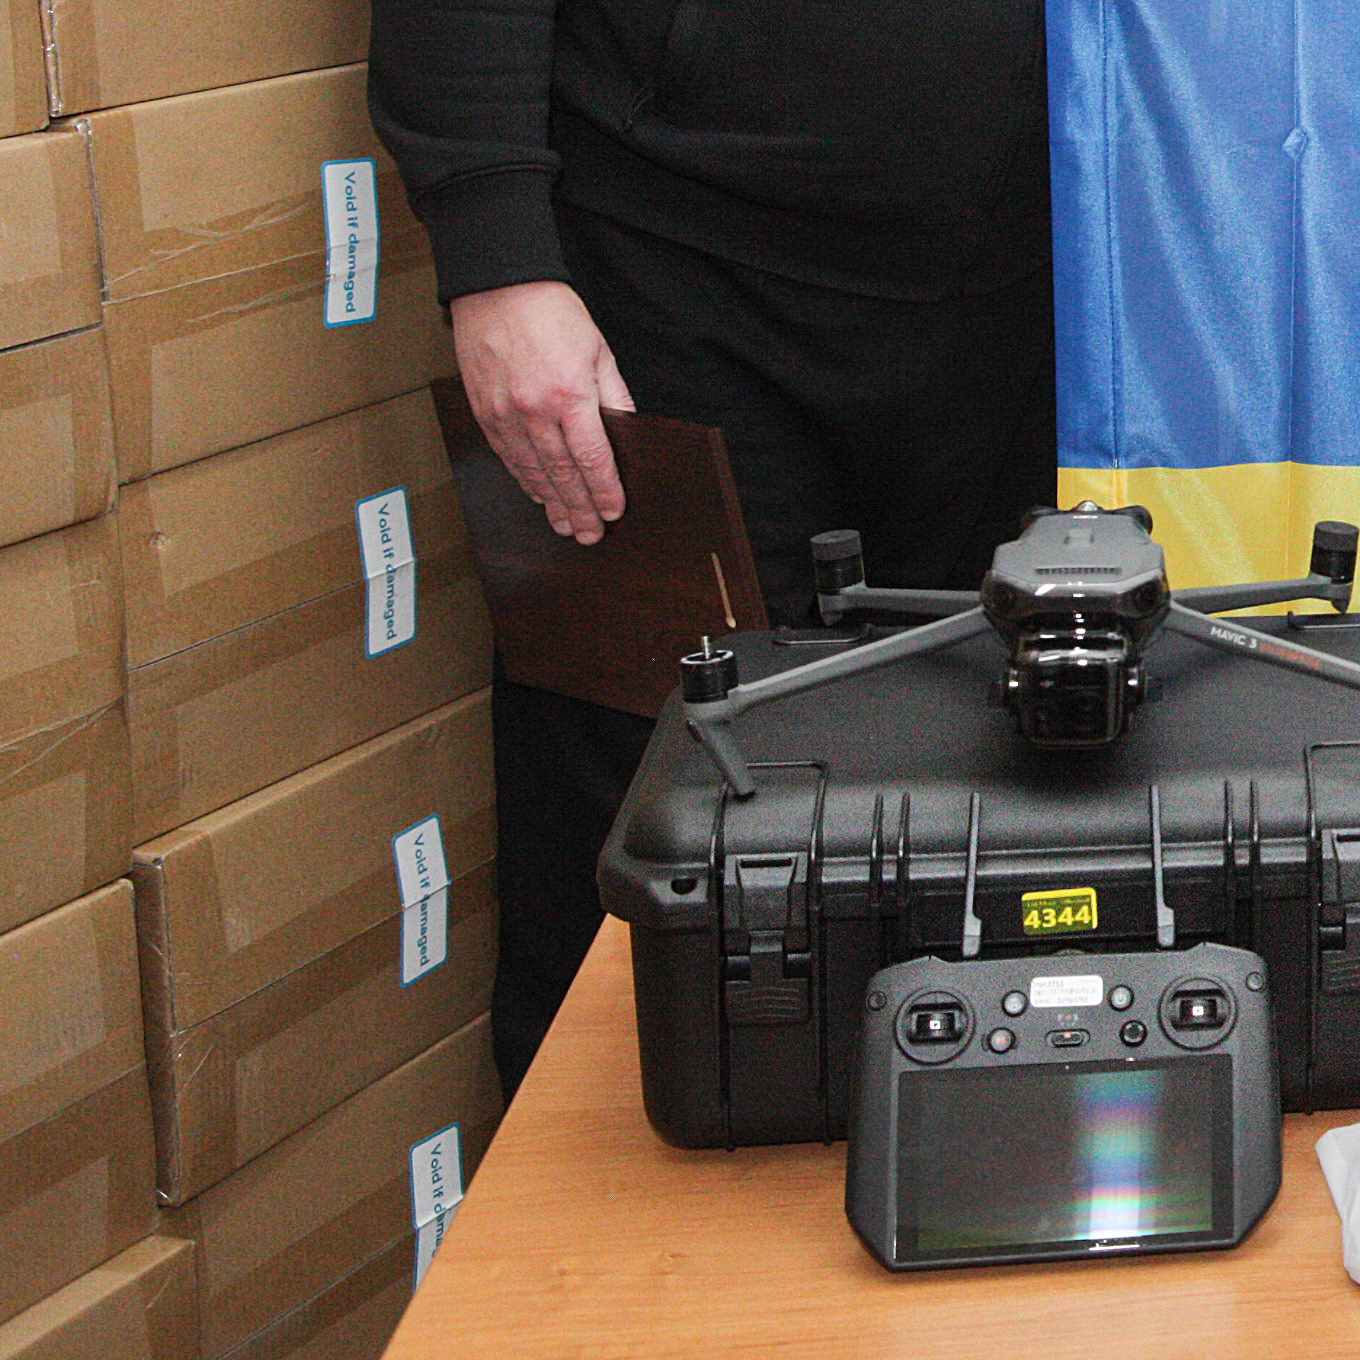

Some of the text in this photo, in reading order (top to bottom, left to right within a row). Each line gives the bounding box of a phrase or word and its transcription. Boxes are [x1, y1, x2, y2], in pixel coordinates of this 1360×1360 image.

[342, 170, 360, 313] Void if damaged
[377, 503, 398, 640] Void if damaged
[1209, 626, 1258, 649] MAVIC 3
[414, 832, 432, 967] Void if damaged
[1024, 905, 1092, 929] 4344
[431, 1142, 443, 1184] Void
[433, 1185, 444, 1198] if
